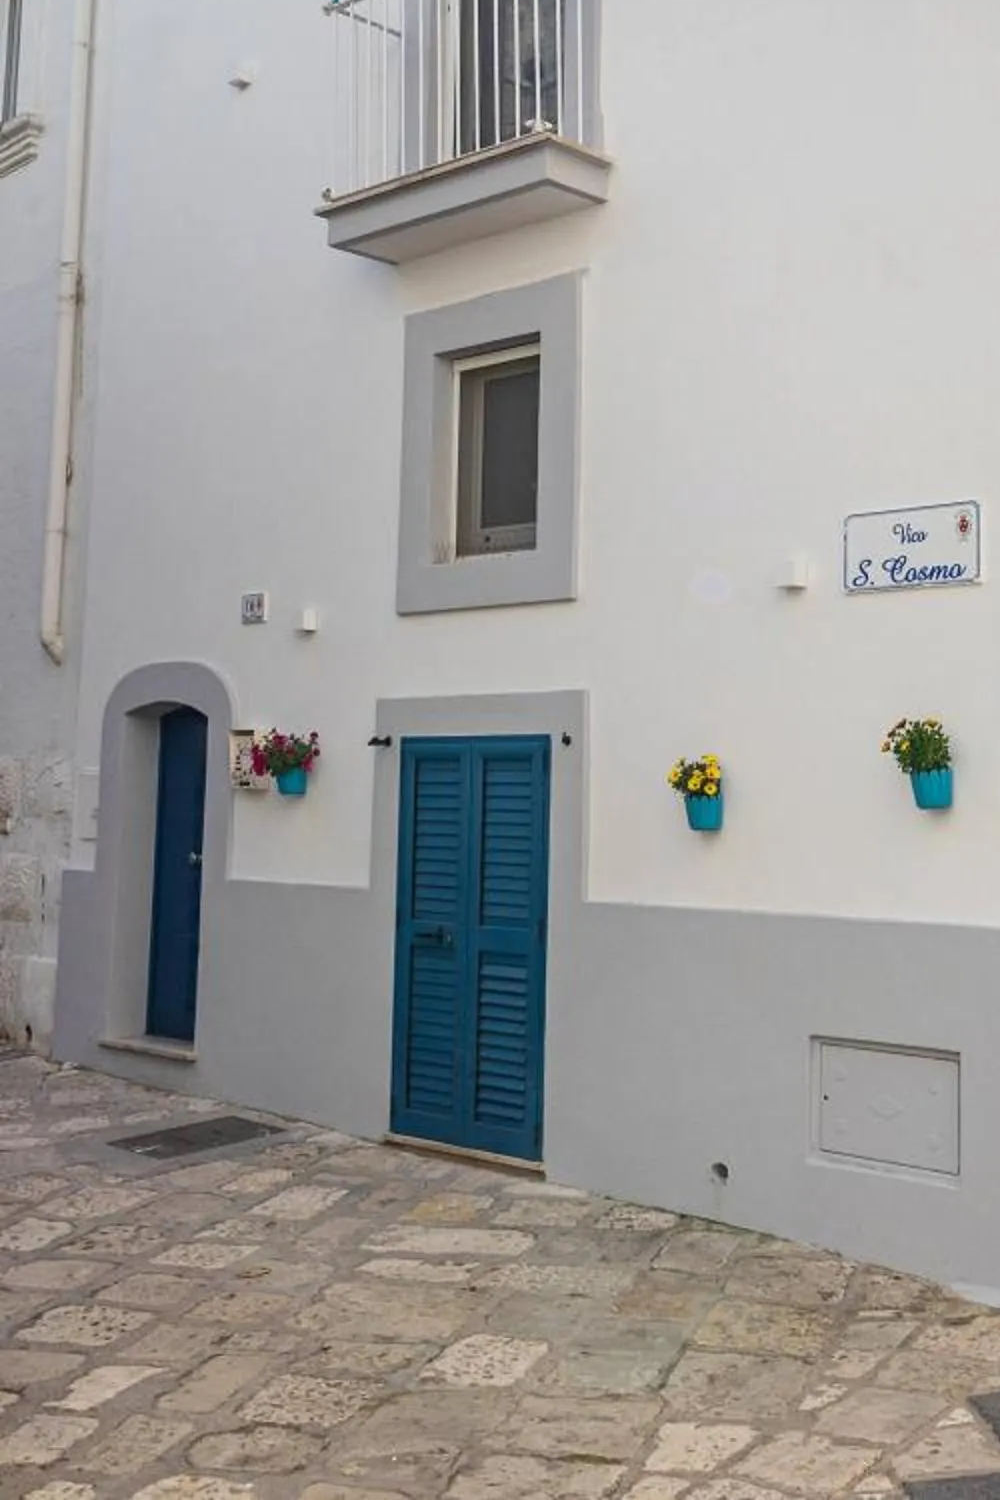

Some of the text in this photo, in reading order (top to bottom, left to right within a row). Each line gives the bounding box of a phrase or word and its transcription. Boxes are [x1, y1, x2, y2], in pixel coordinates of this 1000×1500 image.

[892, 522, 928, 544] Vico
[852, 555, 967, 587] S. Cosmo
